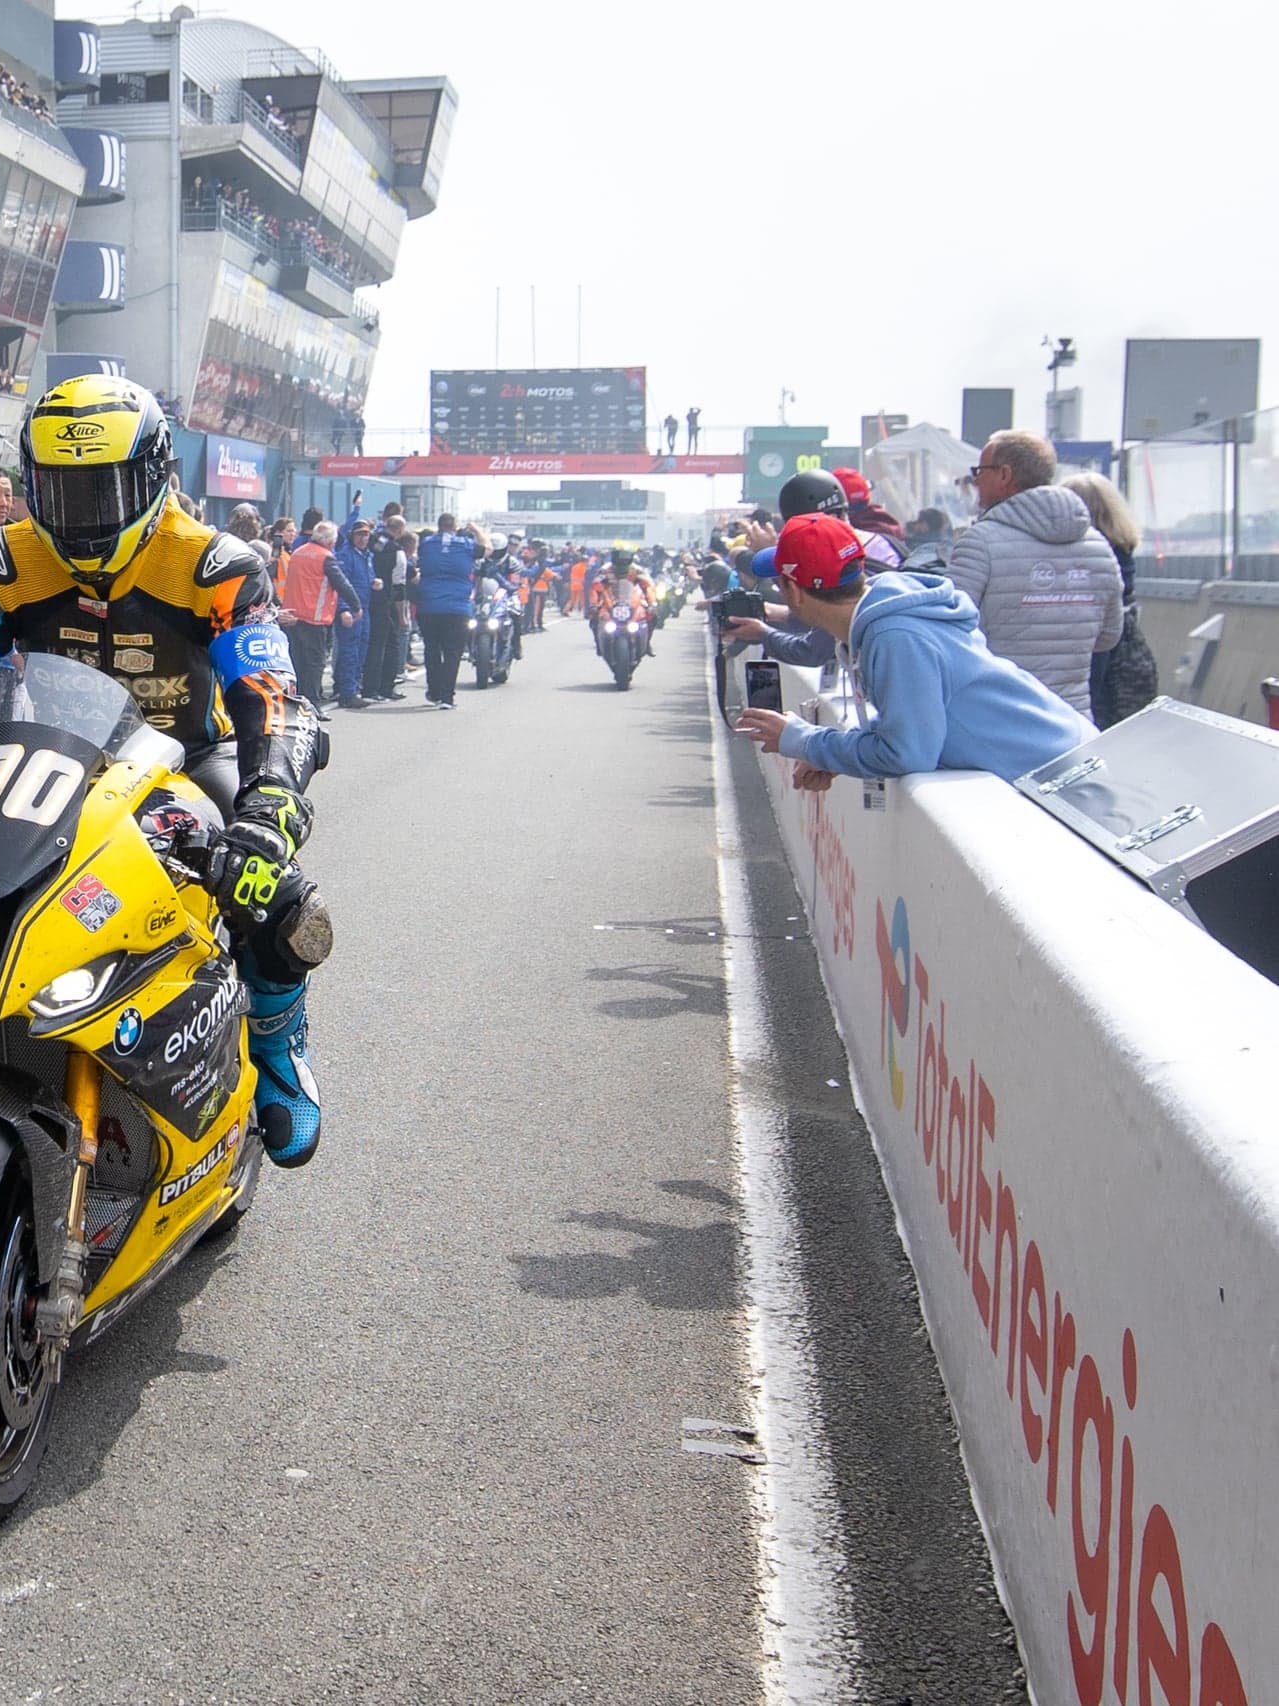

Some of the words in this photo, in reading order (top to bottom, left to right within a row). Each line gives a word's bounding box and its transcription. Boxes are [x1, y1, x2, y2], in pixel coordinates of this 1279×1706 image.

[526, 386, 575, 397] MOTOS
[62, 424, 100, 439] X-lite
[515, 460, 563, 470] MOTOS
[248, 638, 289, 658] EW
[150, 909, 177, 931] EWC
[160, 1139, 226, 1205] PITBULL
